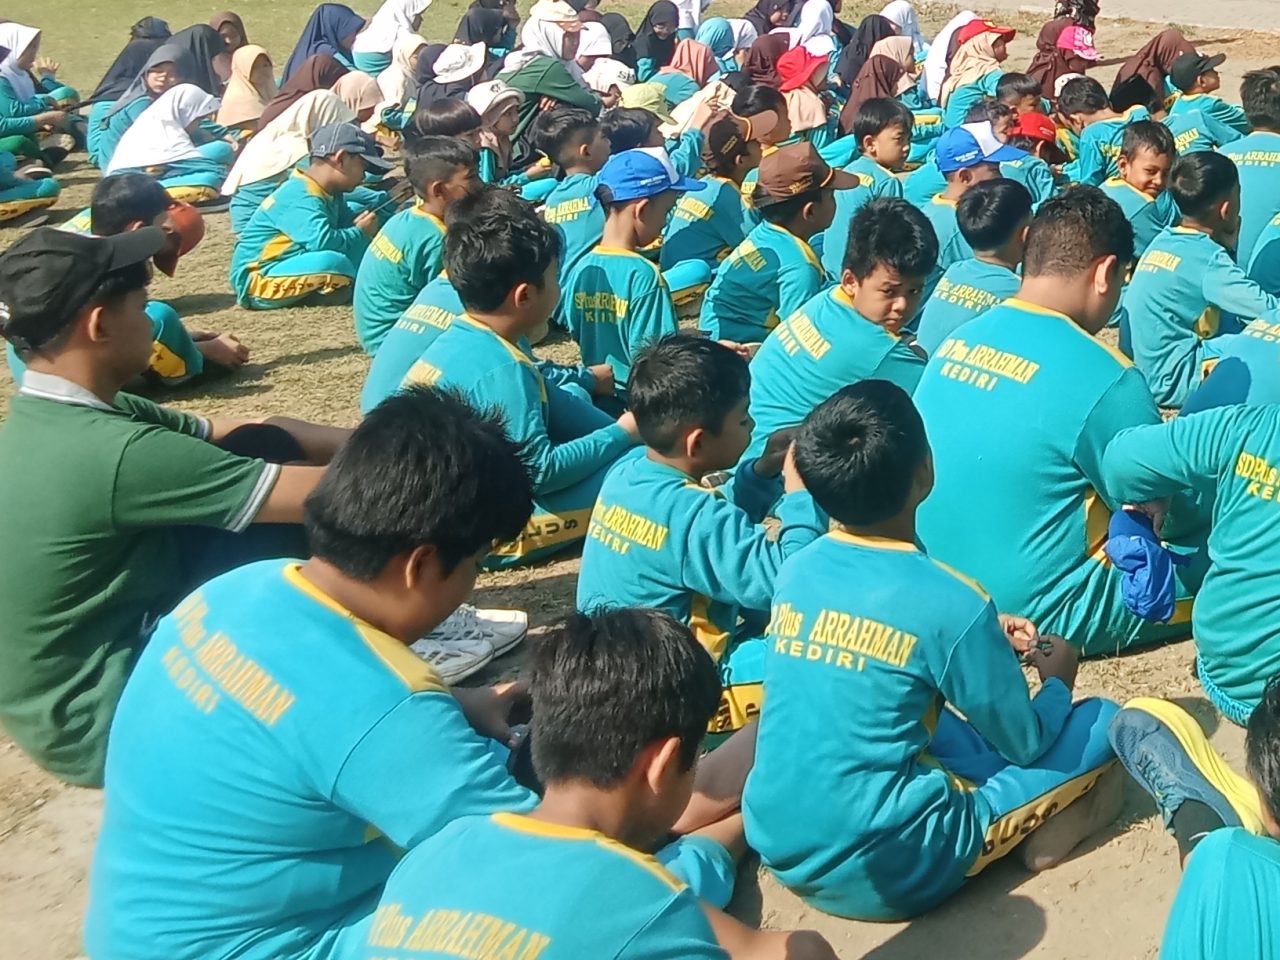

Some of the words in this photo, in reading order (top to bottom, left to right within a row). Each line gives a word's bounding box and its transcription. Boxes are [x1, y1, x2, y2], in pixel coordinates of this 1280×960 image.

[934, 290, 982, 313] KEDIRI
[940, 361, 998, 391] KEDIRI
[965, 344, 1040, 385] ARRAHMAN
[602, 504, 669, 552] ARRAHMAN
[774, 602, 804, 638] Plus
[808, 608, 919, 668] ARRAHMAN
[775, 637, 866, 672] KEDIRI
[162, 645, 221, 716] KEDIRI
[197, 631, 296, 727] ARRAHMAN
[403, 908, 552, 960] ARRAHMAN
